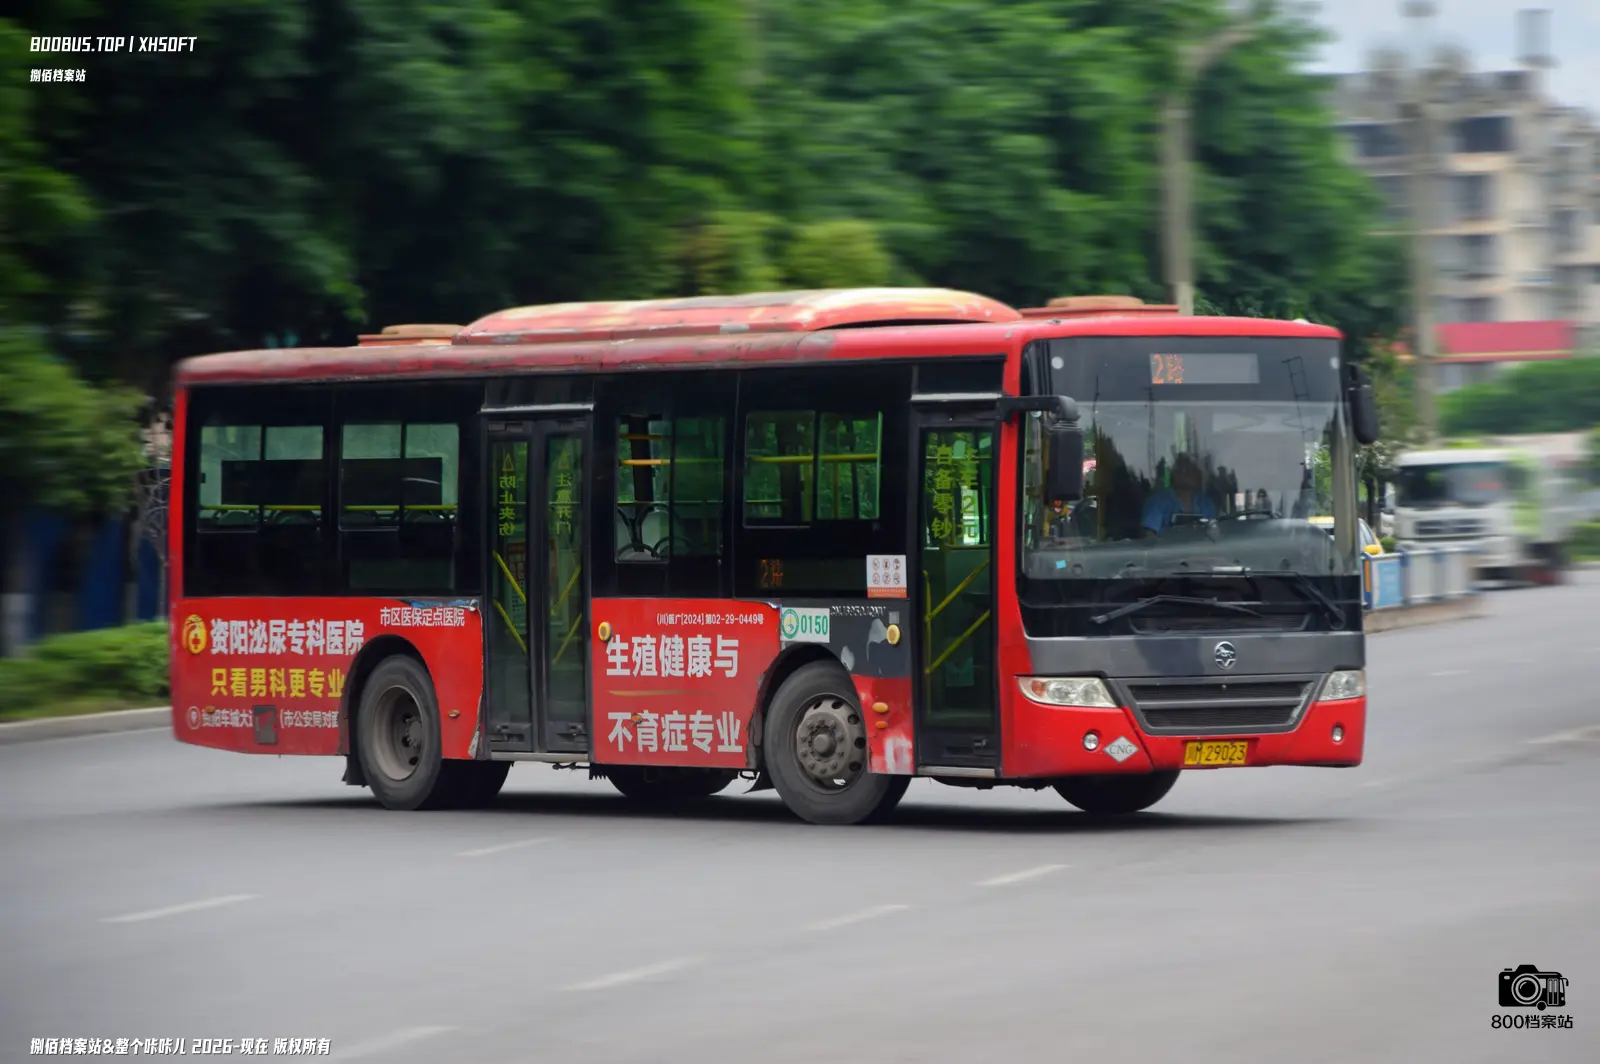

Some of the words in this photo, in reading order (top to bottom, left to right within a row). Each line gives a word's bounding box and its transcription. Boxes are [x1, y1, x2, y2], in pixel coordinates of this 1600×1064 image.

[931, 443, 953, 539] 自备零钞
[380, 606, 466, 627] 市区医保定点医院
[801, 614, 828, 635] 0150
[210, 618, 365, 656] 资阳泌尿专科医院
[606, 634, 739, 678] 生殖健康与
[211, 667, 345, 698] 只看男科更专业
[607, 709, 743, 753] 不育症专业
[1109, 743, 1133, 755] CNG
